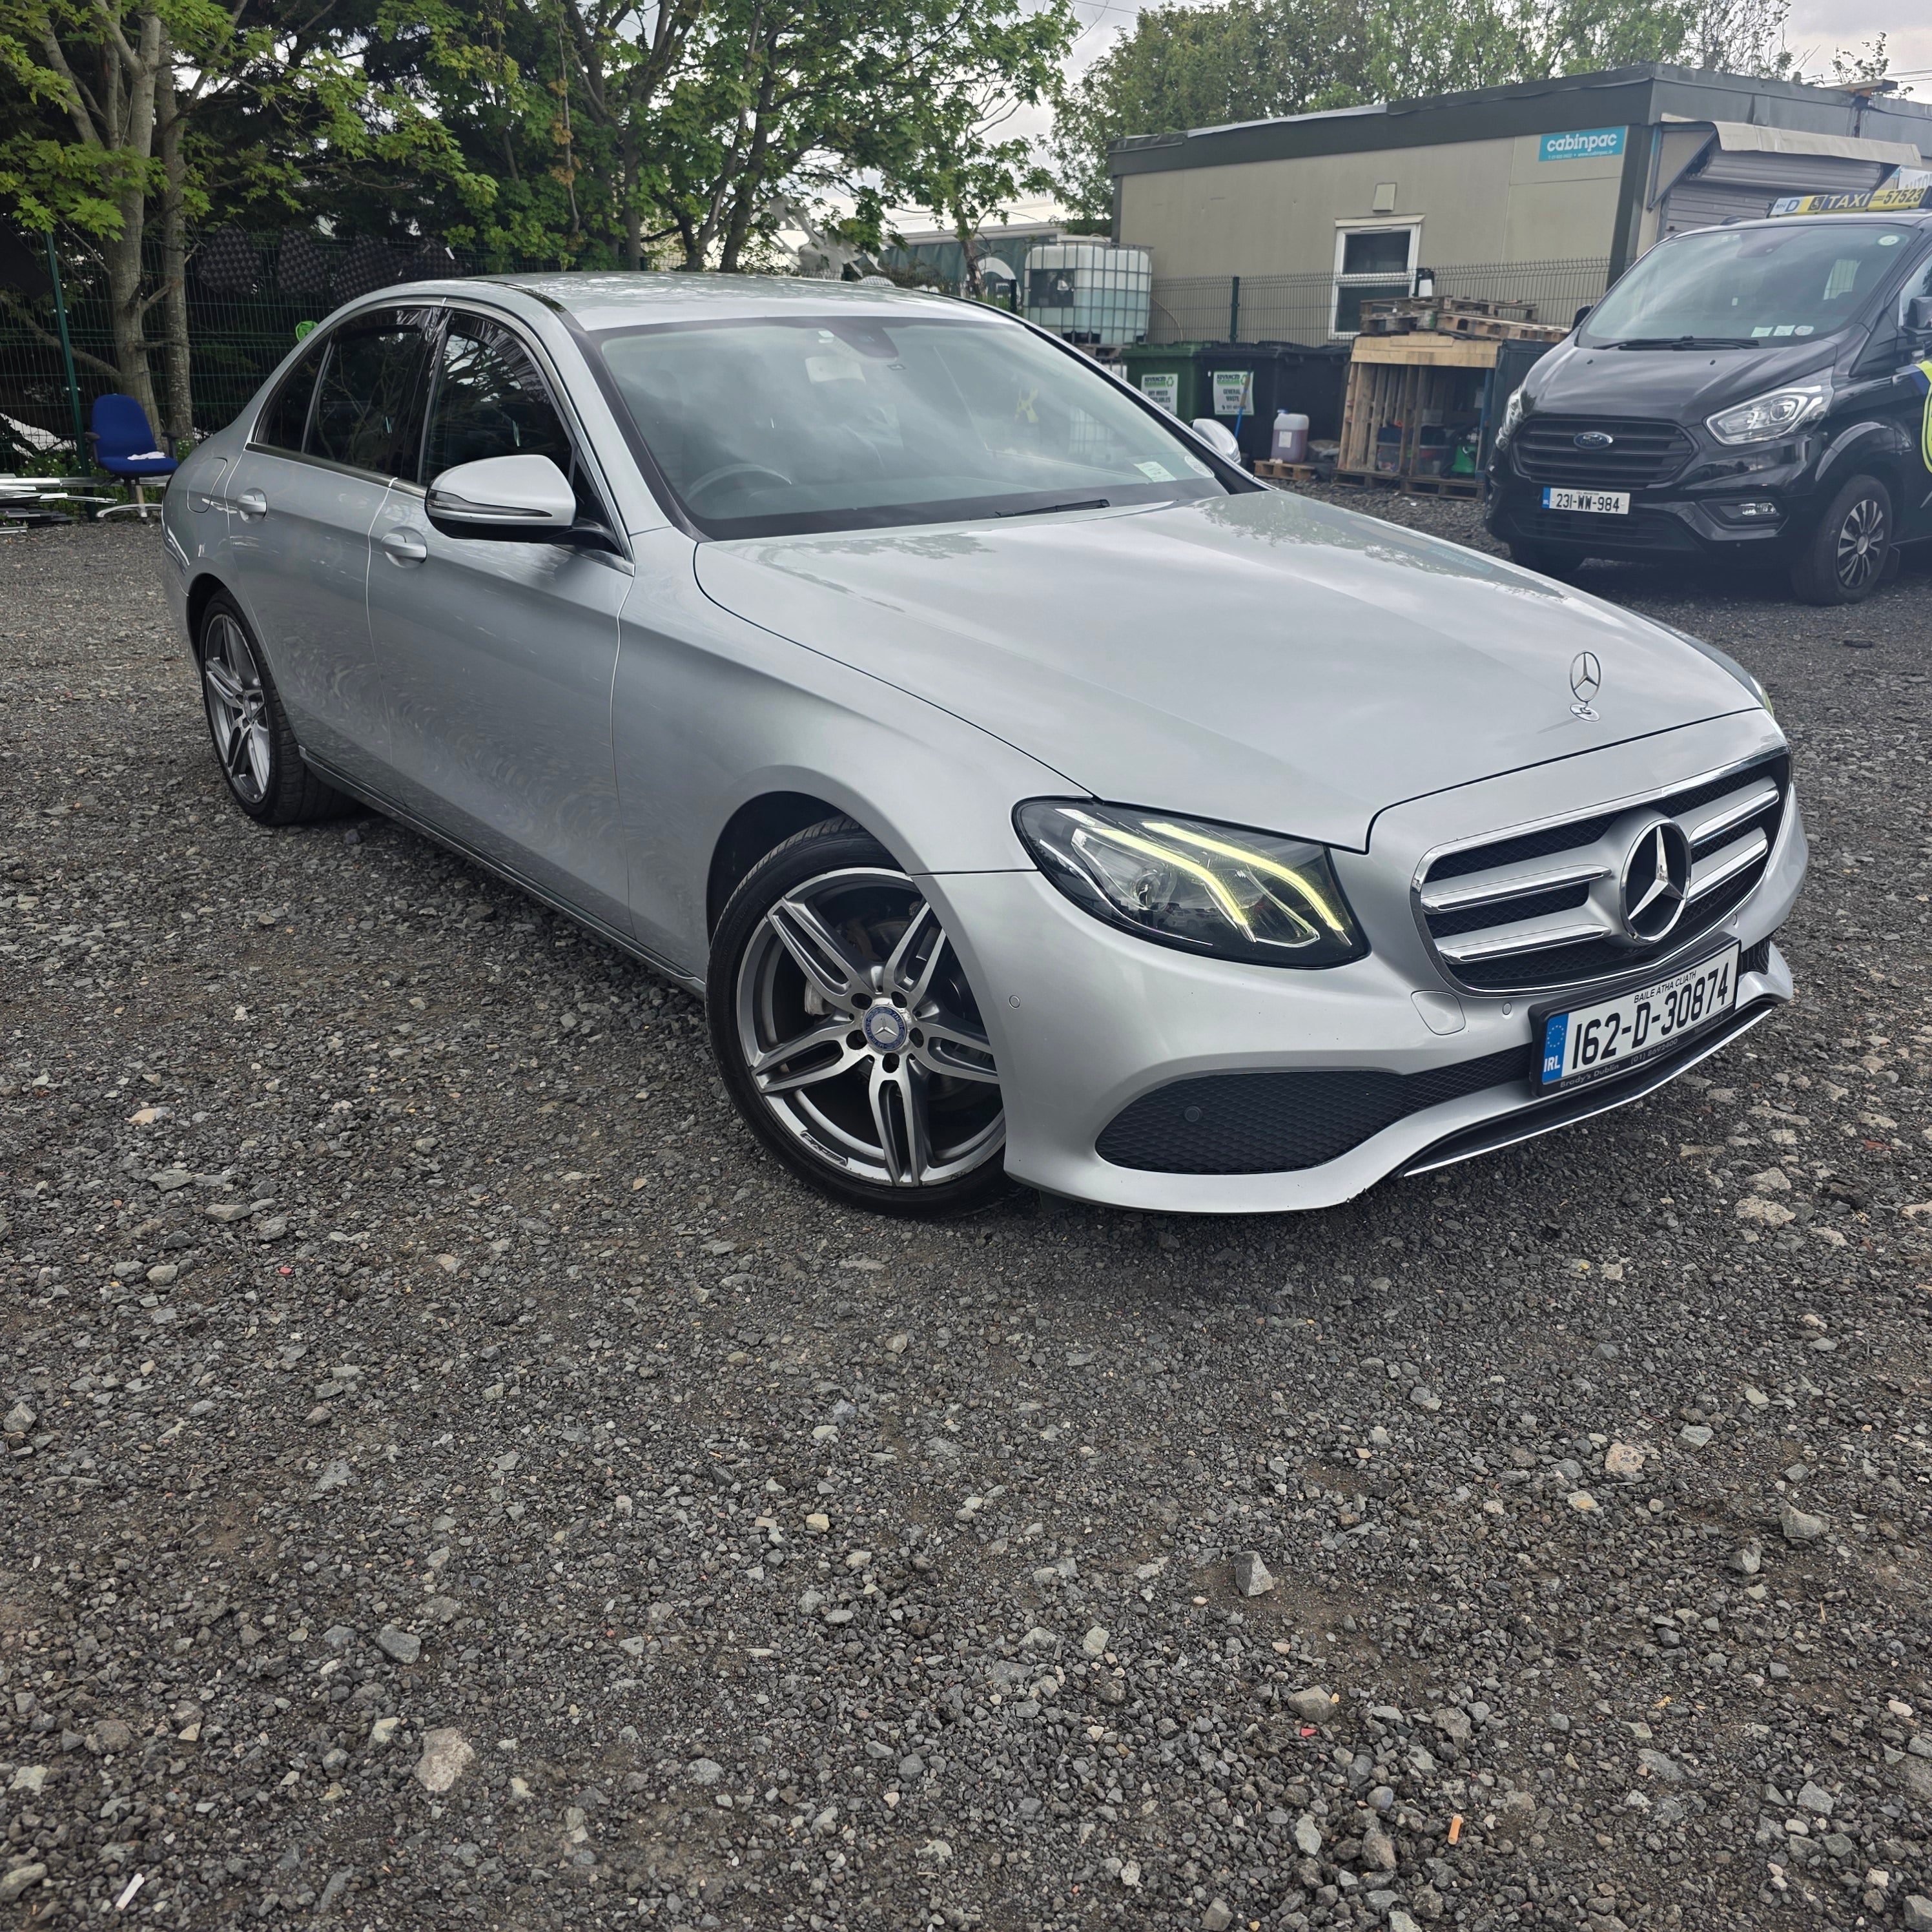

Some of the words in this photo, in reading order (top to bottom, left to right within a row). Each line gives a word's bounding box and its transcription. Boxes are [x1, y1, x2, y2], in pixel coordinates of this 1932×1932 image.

[1547, 133, 1618, 152] cabinpac
[1785, 200, 1800, 212] D
[1828, 194, 1871, 209] TAXI
[1883, 188, 1925, 205] 57523
[1556, 493, 1619, 512] 231-WW-984
[1634, 990, 1655, 1003] BAILE
[1675, 970, 1697, 987] CLIATH
[1572, 960, 1729, 1070] 162-D-30874
[1543, 1054, 1561, 1073] IRL
[1560, 1073, 1592, 1088] Brady's
[1594, 1064, 1619, 1077] Dublin
[1630, 1053, 1647, 1065] (01)
